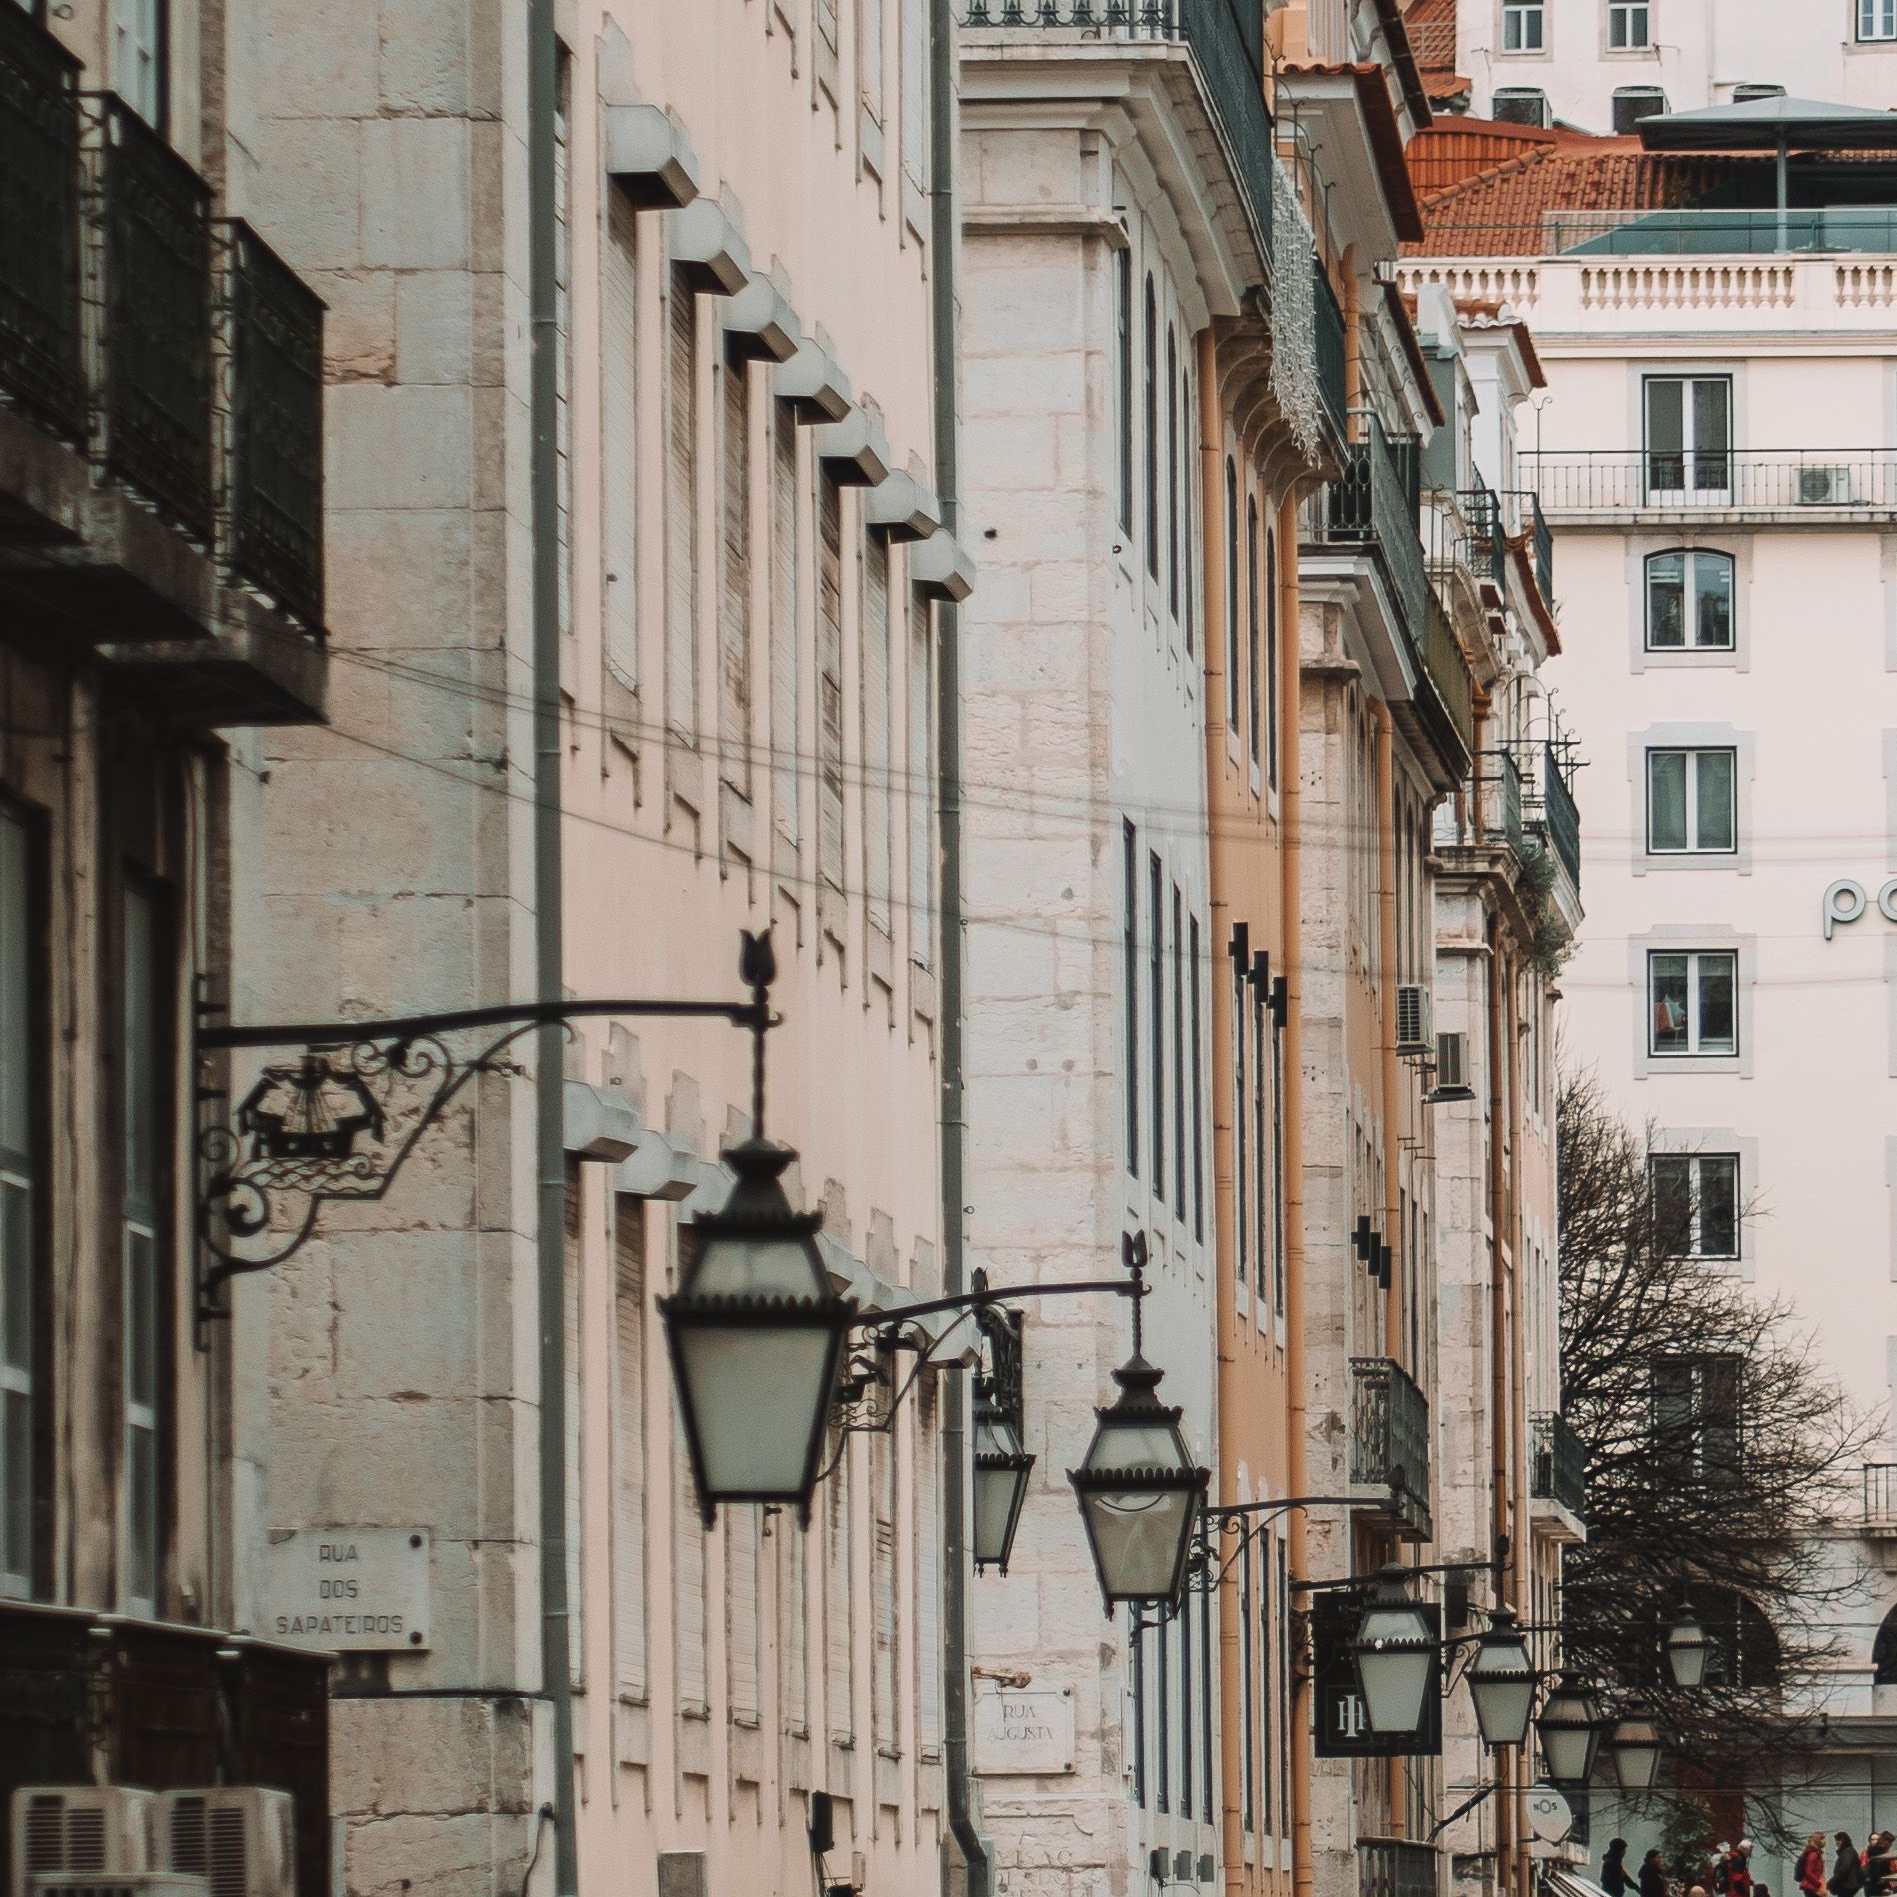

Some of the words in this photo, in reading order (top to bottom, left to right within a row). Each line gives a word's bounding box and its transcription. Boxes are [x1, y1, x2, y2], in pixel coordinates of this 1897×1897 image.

[319, 1544, 359, 1563] RUA
[319, 1579, 359, 1599] DOS
[275, 1615, 404, 1635] SAPATEIROS
[1003, 1704, 1036, 1719] RUA
[1532, 1799, 1558, 1815] NOS
